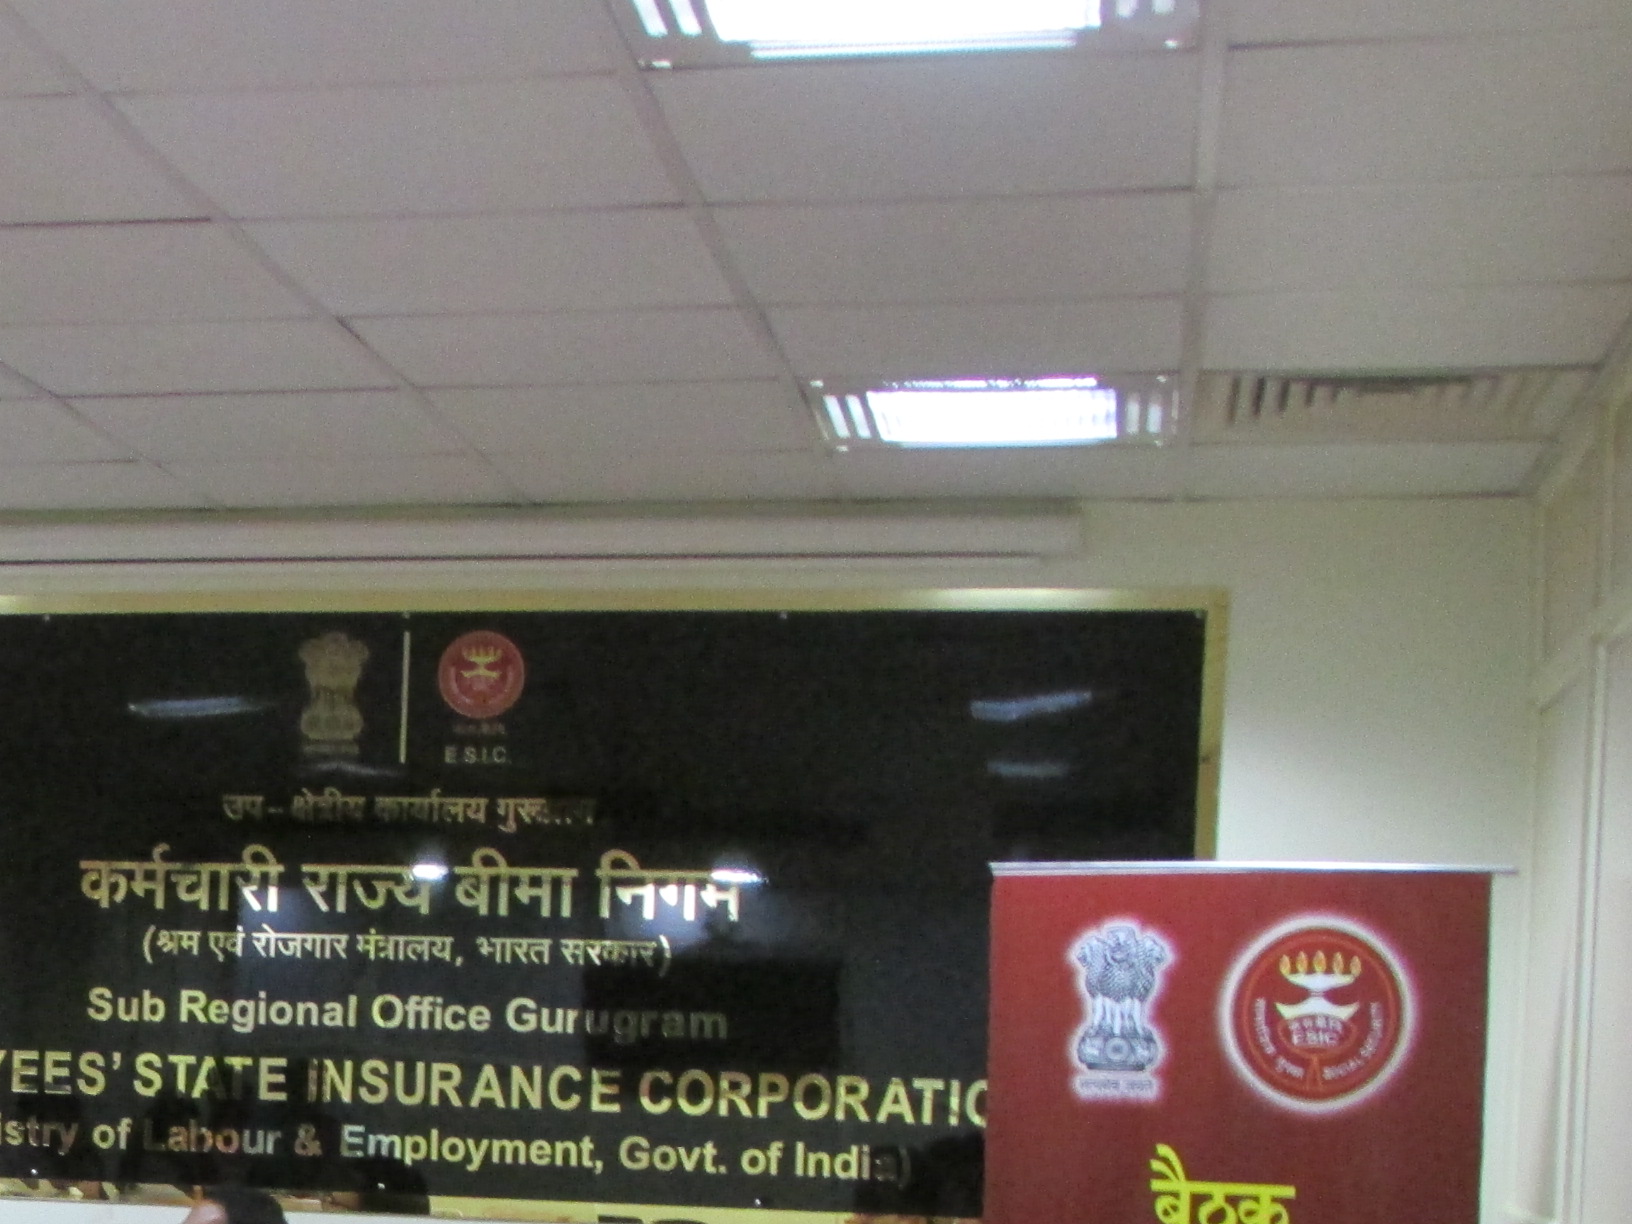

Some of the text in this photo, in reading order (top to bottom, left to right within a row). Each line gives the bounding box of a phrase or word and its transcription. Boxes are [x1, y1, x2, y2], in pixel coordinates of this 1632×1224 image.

[79, 842, 747, 922] कर्मचारी राज्य बीमा निगम
[142, 922, 672, 977] (श्रम एवं रोजगार मंत्रालय, भारत सरकार)
[86, 986, 728, 1044] Sub Regional Office Gurugram
[133, 1053, 288, 1101] STATE
[308, 1057, 622, 1113] INSURANCE
[639, 1069, 989, 1128] CORPORATIO
[91, 1117, 133, 1151] of
[143, 1118, 283, 1155] Labour
[294, 1123, 323, 1158] &
[340, 1126, 604, 1175] Employment,
[619, 1135, 727, 1175] Govt.
[740, 1140, 785, 1177] of
